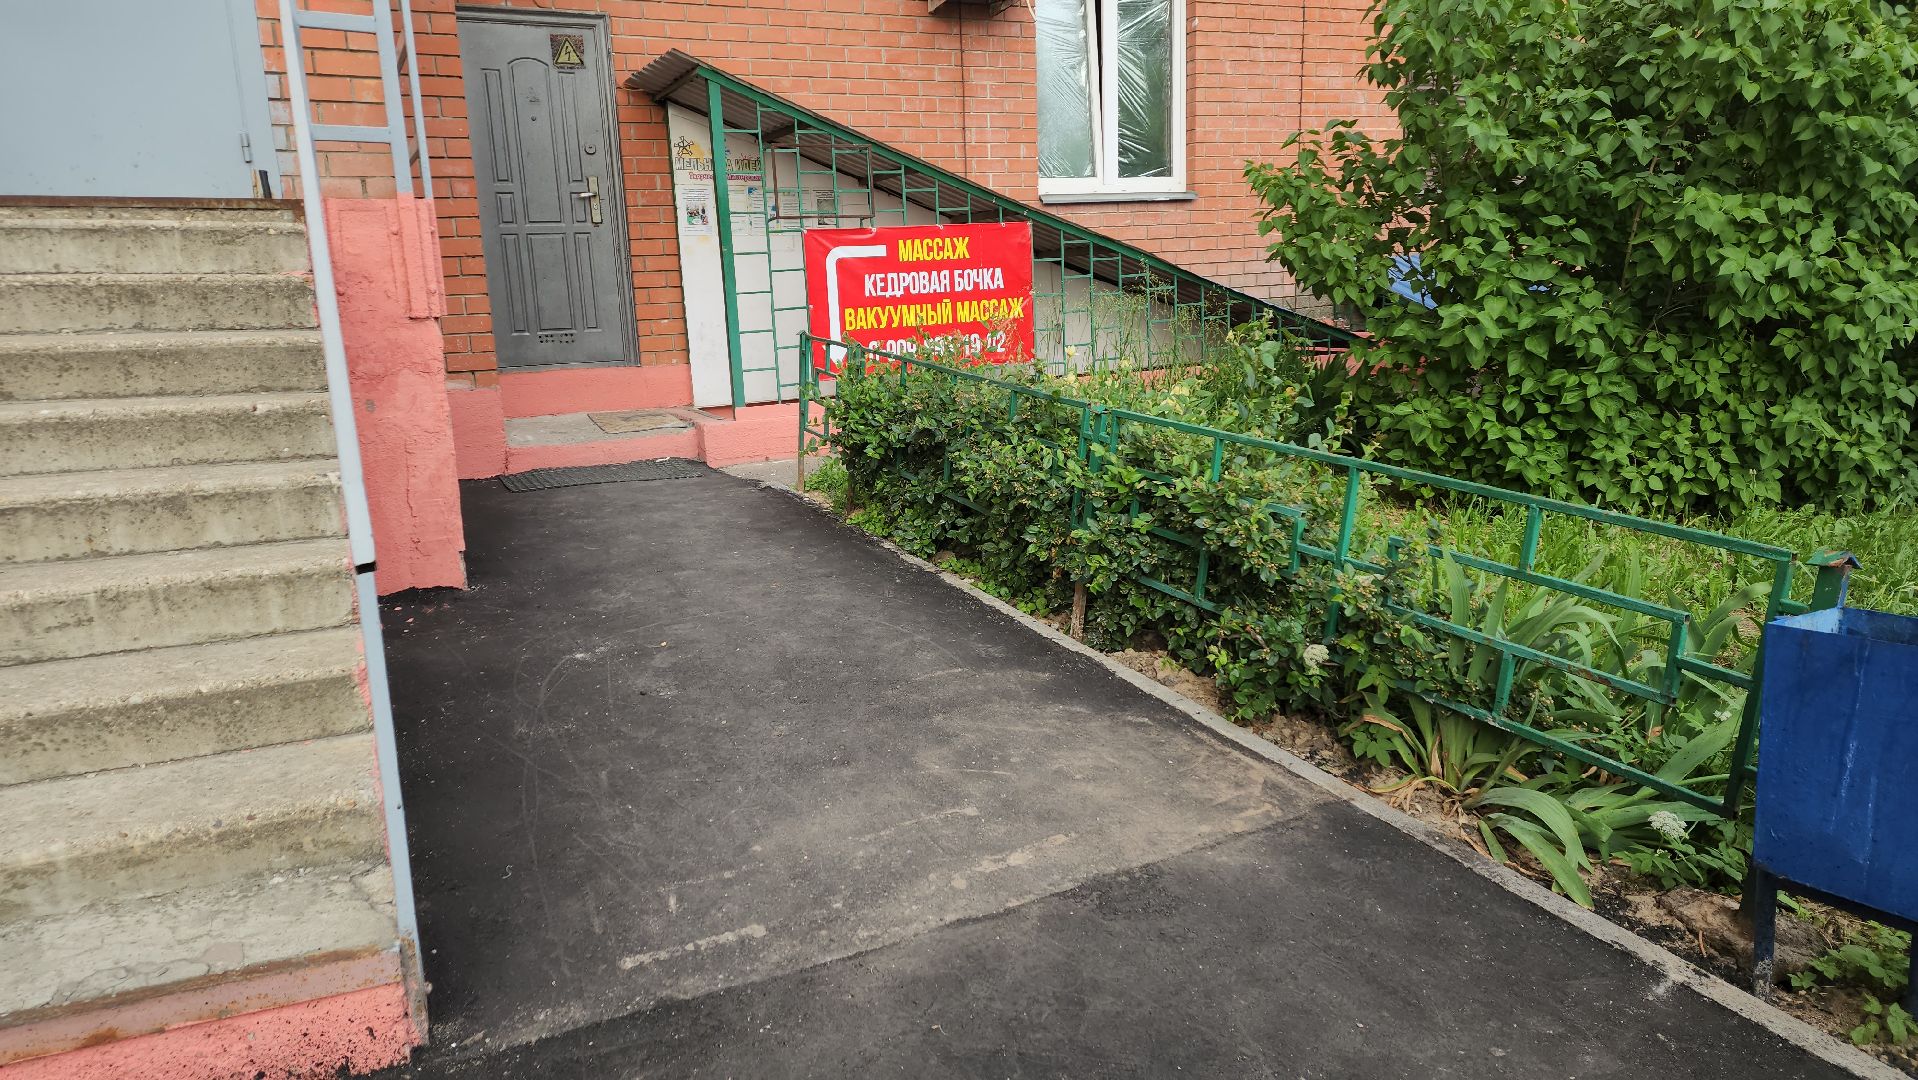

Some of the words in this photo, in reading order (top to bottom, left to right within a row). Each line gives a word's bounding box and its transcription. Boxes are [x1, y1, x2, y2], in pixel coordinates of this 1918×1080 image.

[674, 157, 733, 171] МЕЛЬНА
[898, 237, 971, 262] МАССАЖ
[864, 270, 950, 297] КЕДРОВАЯ
[954, 267, 1004, 293] БОЧКА
[845, 299, 953, 331] ВАКУУМНЫЙ
[956, 297, 1024, 322] МАССАЖ
